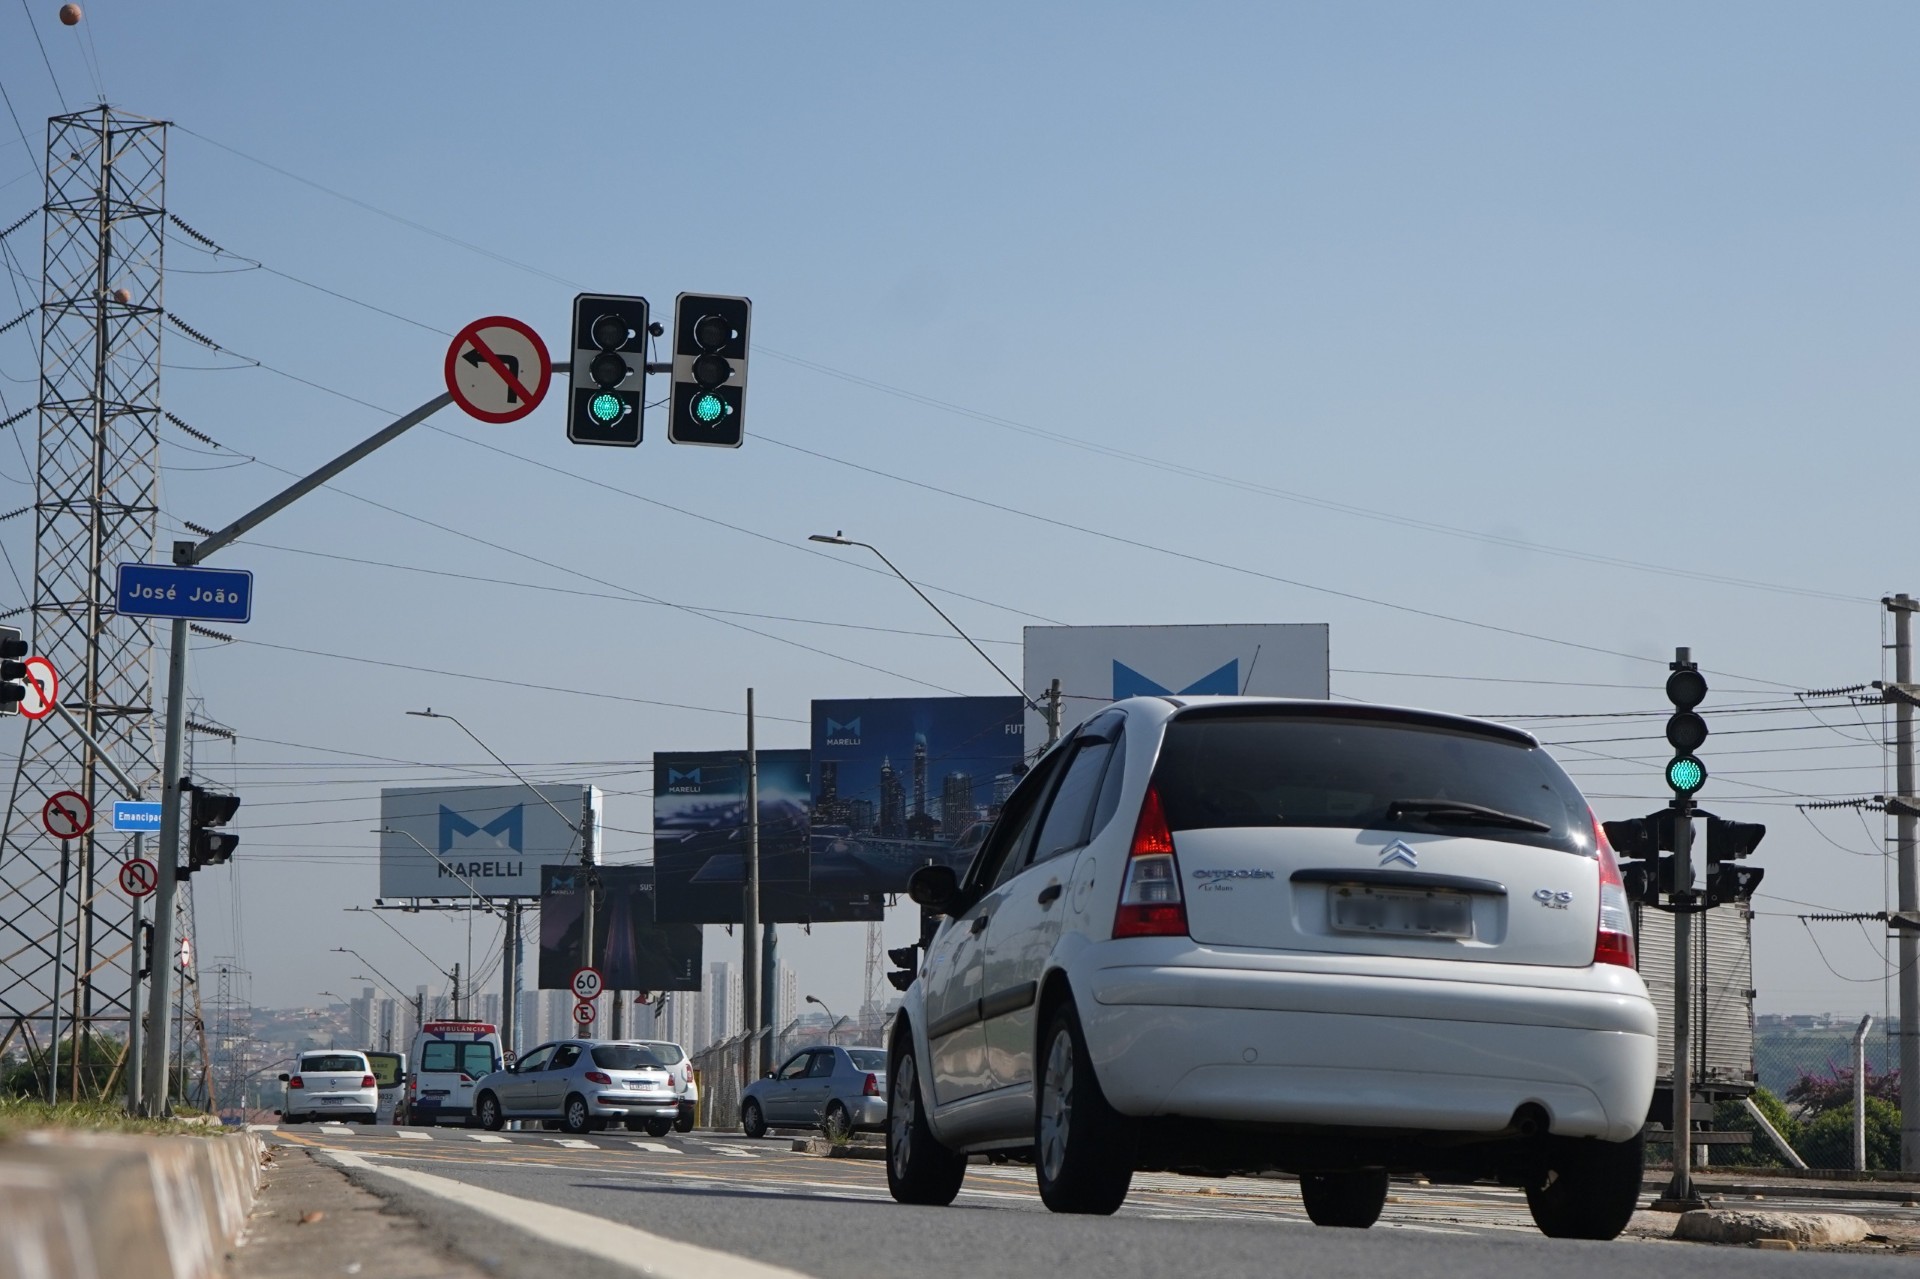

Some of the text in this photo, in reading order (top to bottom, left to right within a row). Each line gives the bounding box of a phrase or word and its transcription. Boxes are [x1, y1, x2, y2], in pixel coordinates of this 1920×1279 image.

[129, 583, 239, 604] José João
[827, 738, 861, 746] MARELLI
[438, 861, 523, 878] MARELLI
[576, 974, 597, 989] 60
